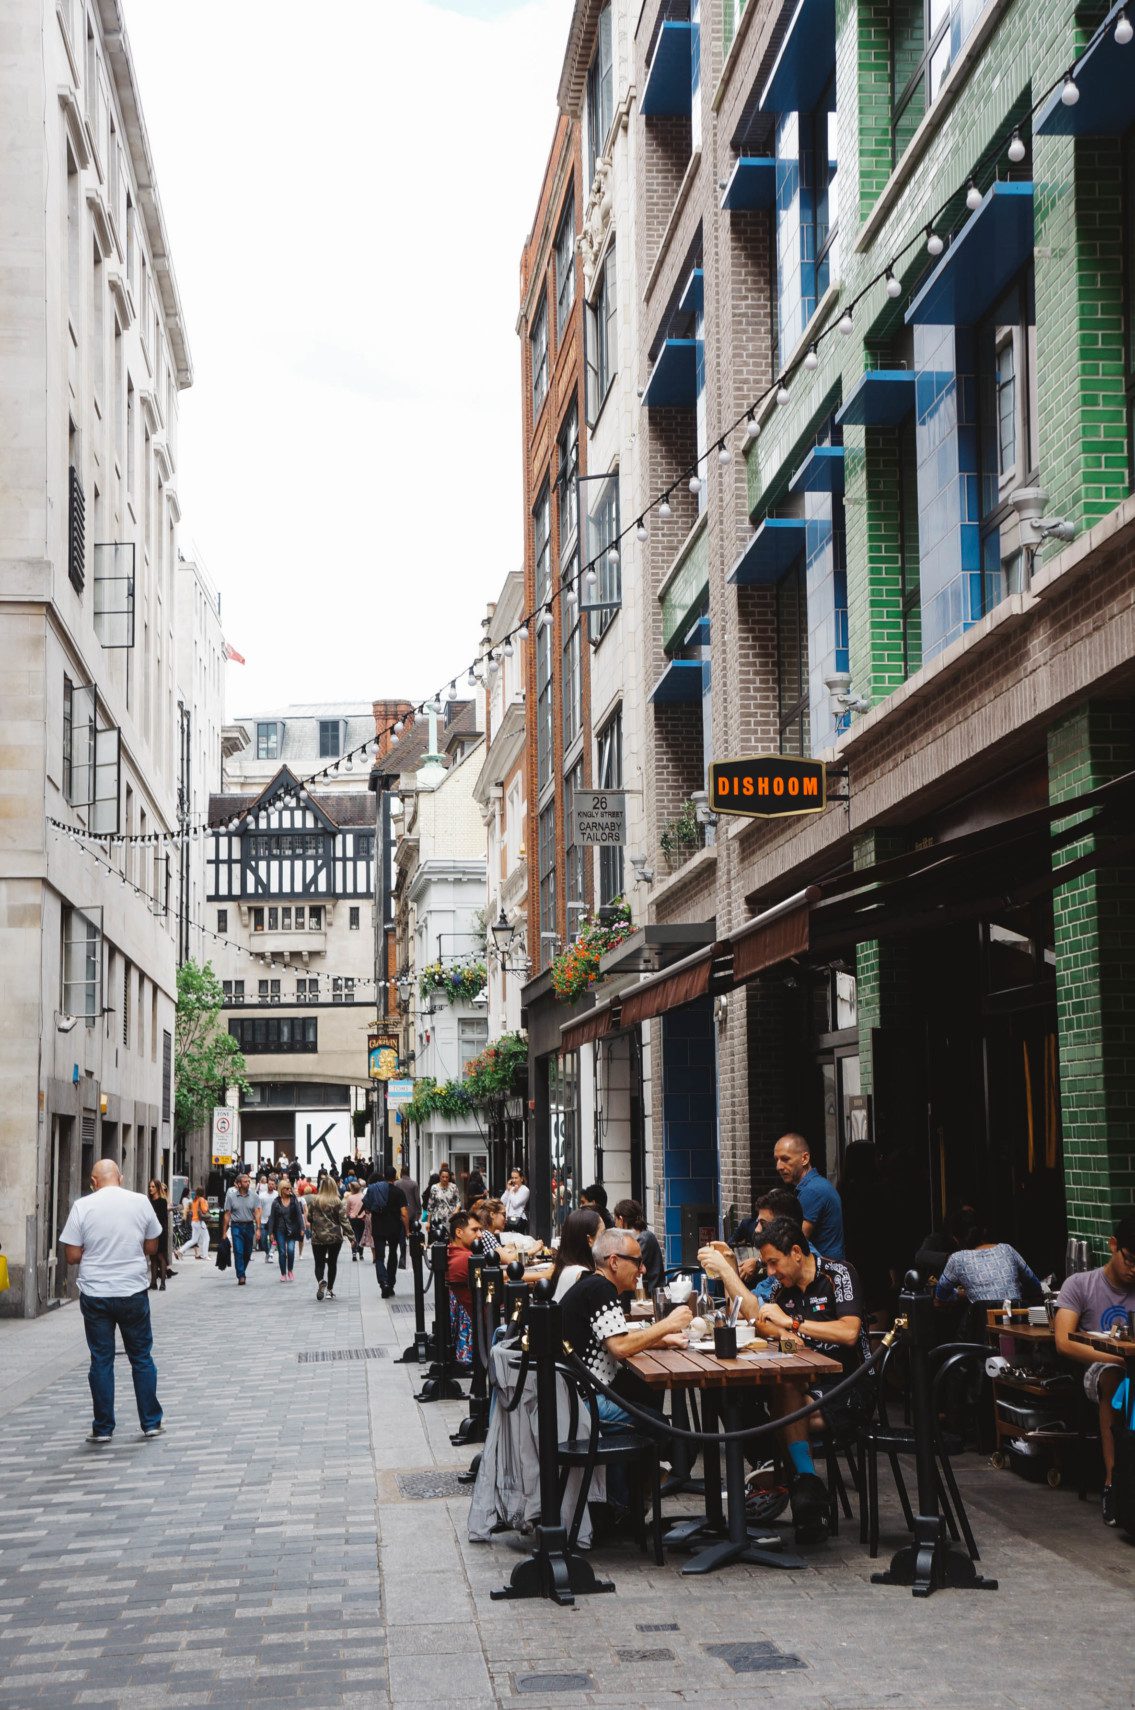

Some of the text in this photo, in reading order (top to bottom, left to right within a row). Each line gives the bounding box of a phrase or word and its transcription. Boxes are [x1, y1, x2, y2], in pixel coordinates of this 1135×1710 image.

[718, 776, 818, 796] DISHOOM
[592, 796, 607, 810] 26
[579, 822, 622, 831] CARNABY
[581, 833, 620, 842] TAILORS
[306, 1123, 338, 1165] K
